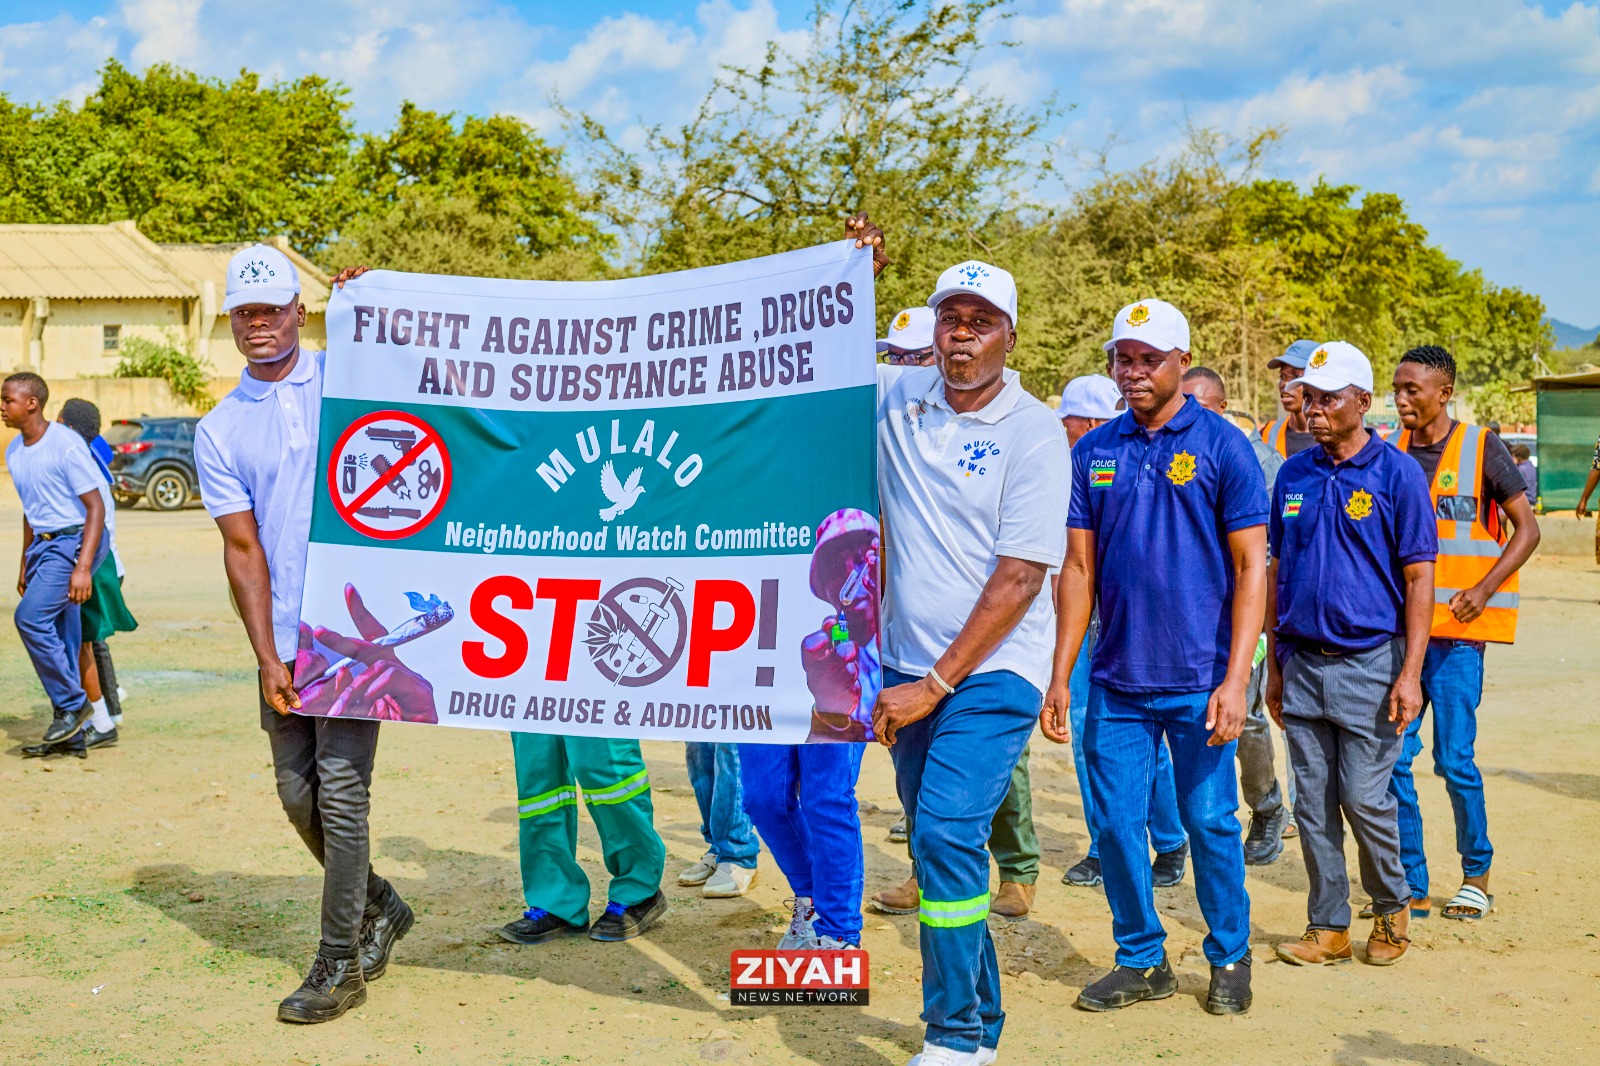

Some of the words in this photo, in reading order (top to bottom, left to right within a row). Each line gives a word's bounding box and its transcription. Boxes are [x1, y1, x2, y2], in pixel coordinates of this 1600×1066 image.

[239, 260, 275, 279] MULALO
[958, 264, 990, 277] MULALO
[353, 305, 470, 350] FIGHT
[481, 314, 637, 355] AGAINST
[647, 302, 742, 352] CRIME
[418, 357, 496, 398] AND
[510, 355, 708, 402] SUBSTANCE
[717, 341, 814, 393] ABUSE
[535, 418, 703, 493] MULALO
[957, 459, 986, 476] NWC
[1090, 459, 1117, 468] POLICE
[1285, 493, 1304, 501] POLICE
[445, 521, 608, 553] Neighborhood
[616, 524, 687, 551] Watch
[695, 521, 811, 551] Committee
[448, 690, 517, 719] DRUG
[522, 695, 606, 725] ABUSE
[613, 700, 632, 726] &
[639, 702, 773, 731] ADDICTION
